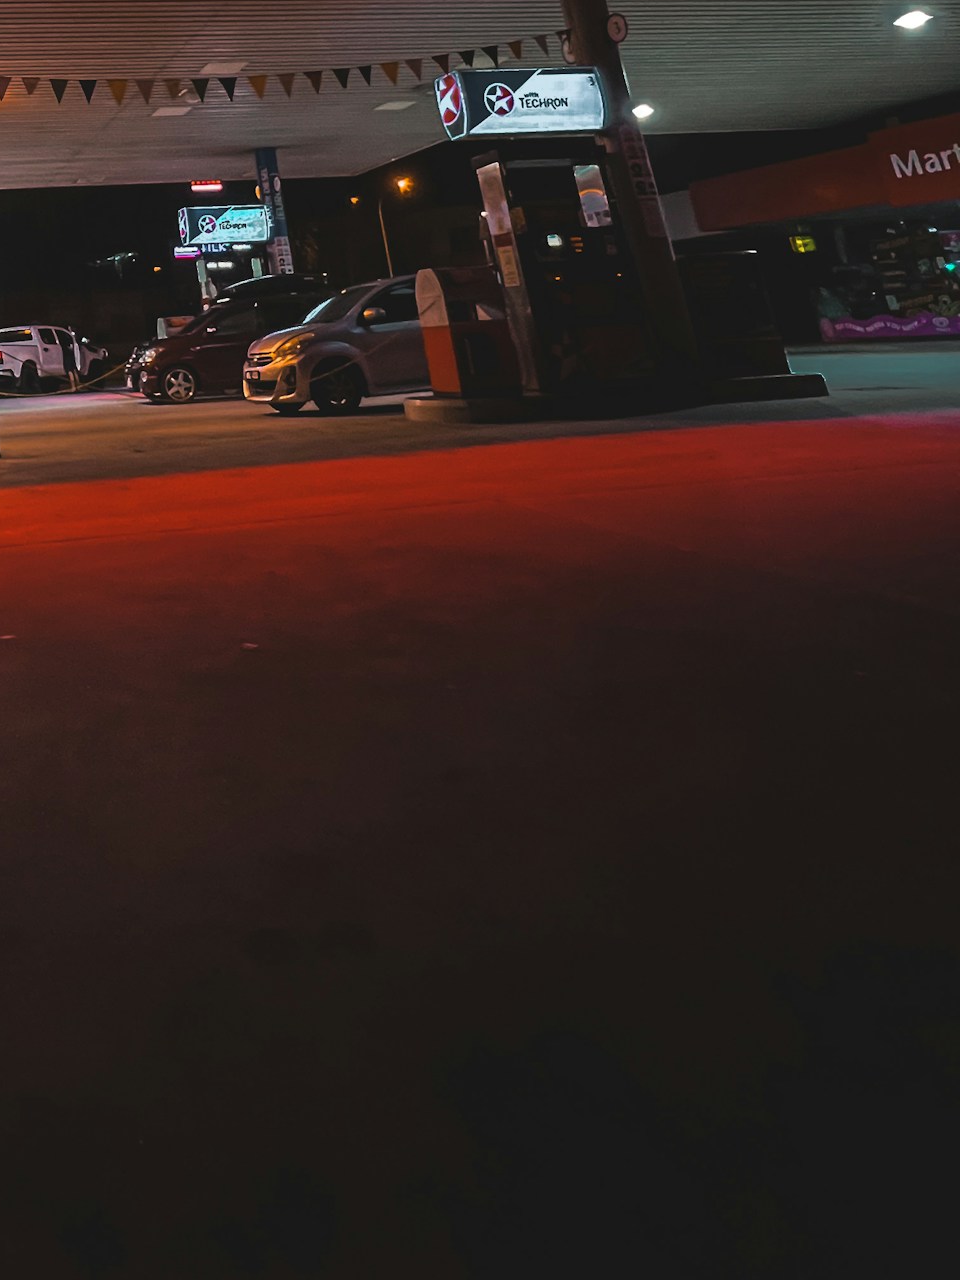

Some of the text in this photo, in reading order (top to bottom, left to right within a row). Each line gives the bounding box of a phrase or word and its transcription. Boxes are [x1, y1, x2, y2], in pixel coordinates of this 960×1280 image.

[587, 76, 595, 86] 3
[518, 97, 568, 109] TECHRON
[889, 143, 960, 179] Mart
